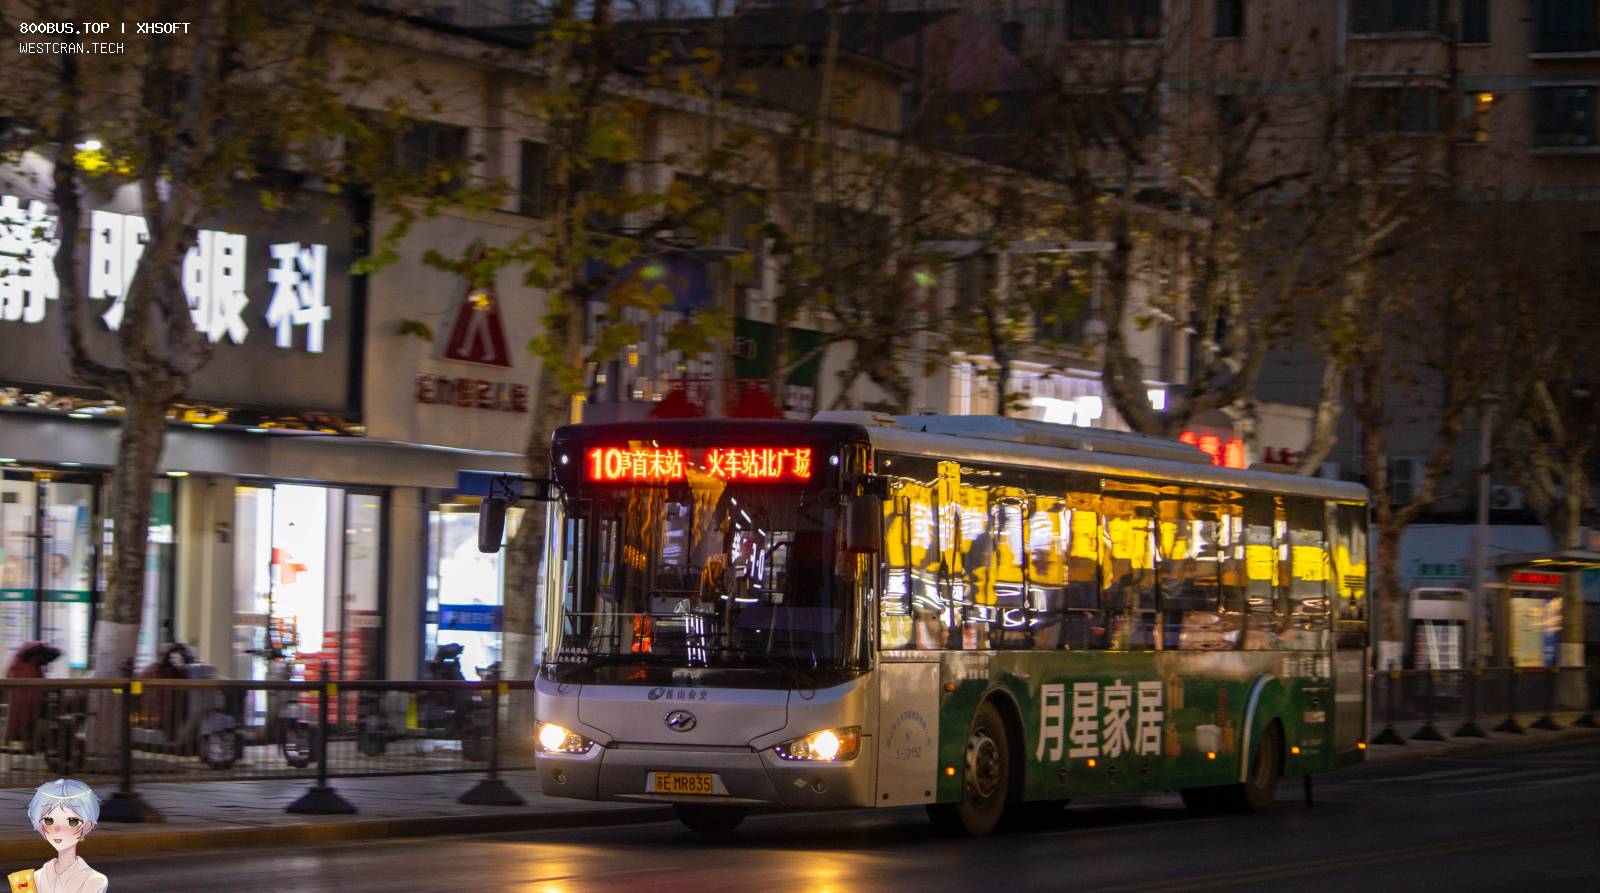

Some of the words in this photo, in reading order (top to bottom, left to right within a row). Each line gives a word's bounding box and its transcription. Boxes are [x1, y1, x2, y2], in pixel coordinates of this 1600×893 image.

[707, 448, 811, 479] 火车站北广场
[1036, 679, 1163, 762] 月星家居
